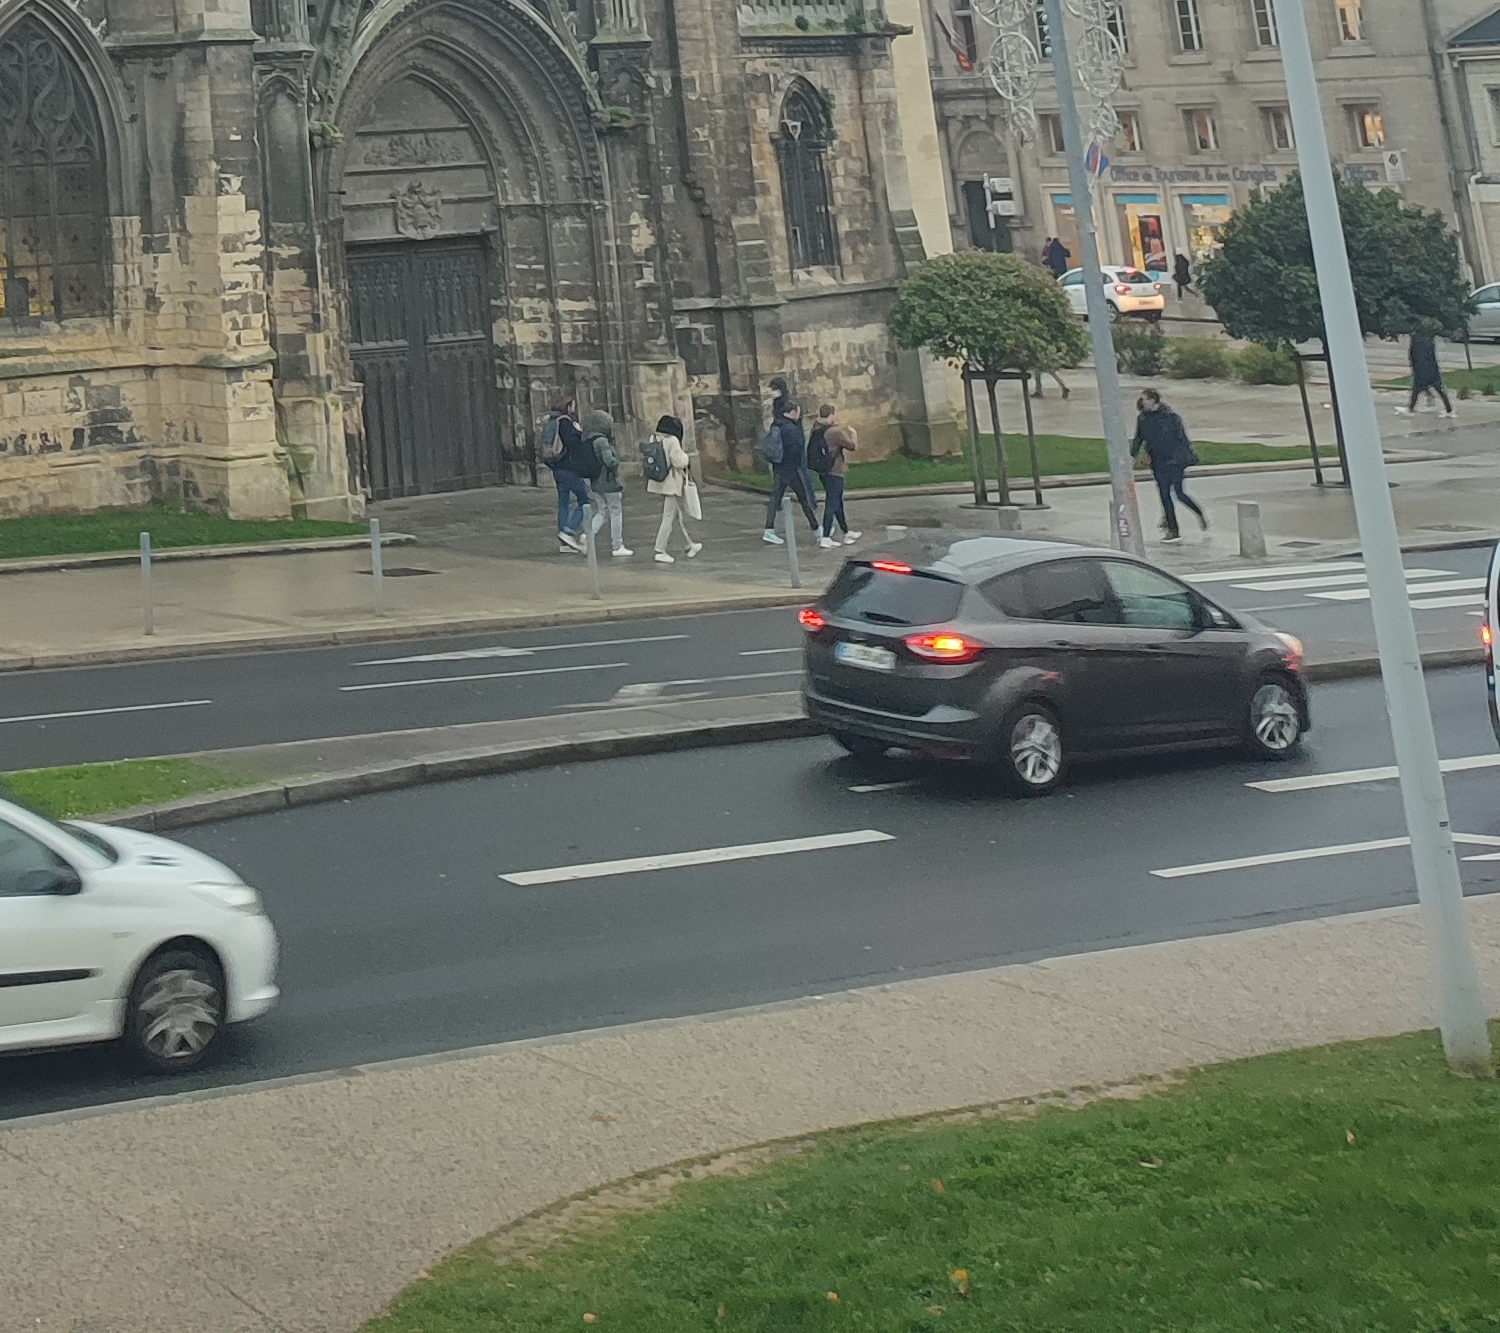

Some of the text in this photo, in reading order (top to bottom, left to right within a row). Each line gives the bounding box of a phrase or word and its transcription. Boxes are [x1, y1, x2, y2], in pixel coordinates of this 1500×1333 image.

[1110, 165, 1140, 182] Office
[1154, 166, 1200, 182] Tourisme
[1232, 165, 1277, 184] Congrès
